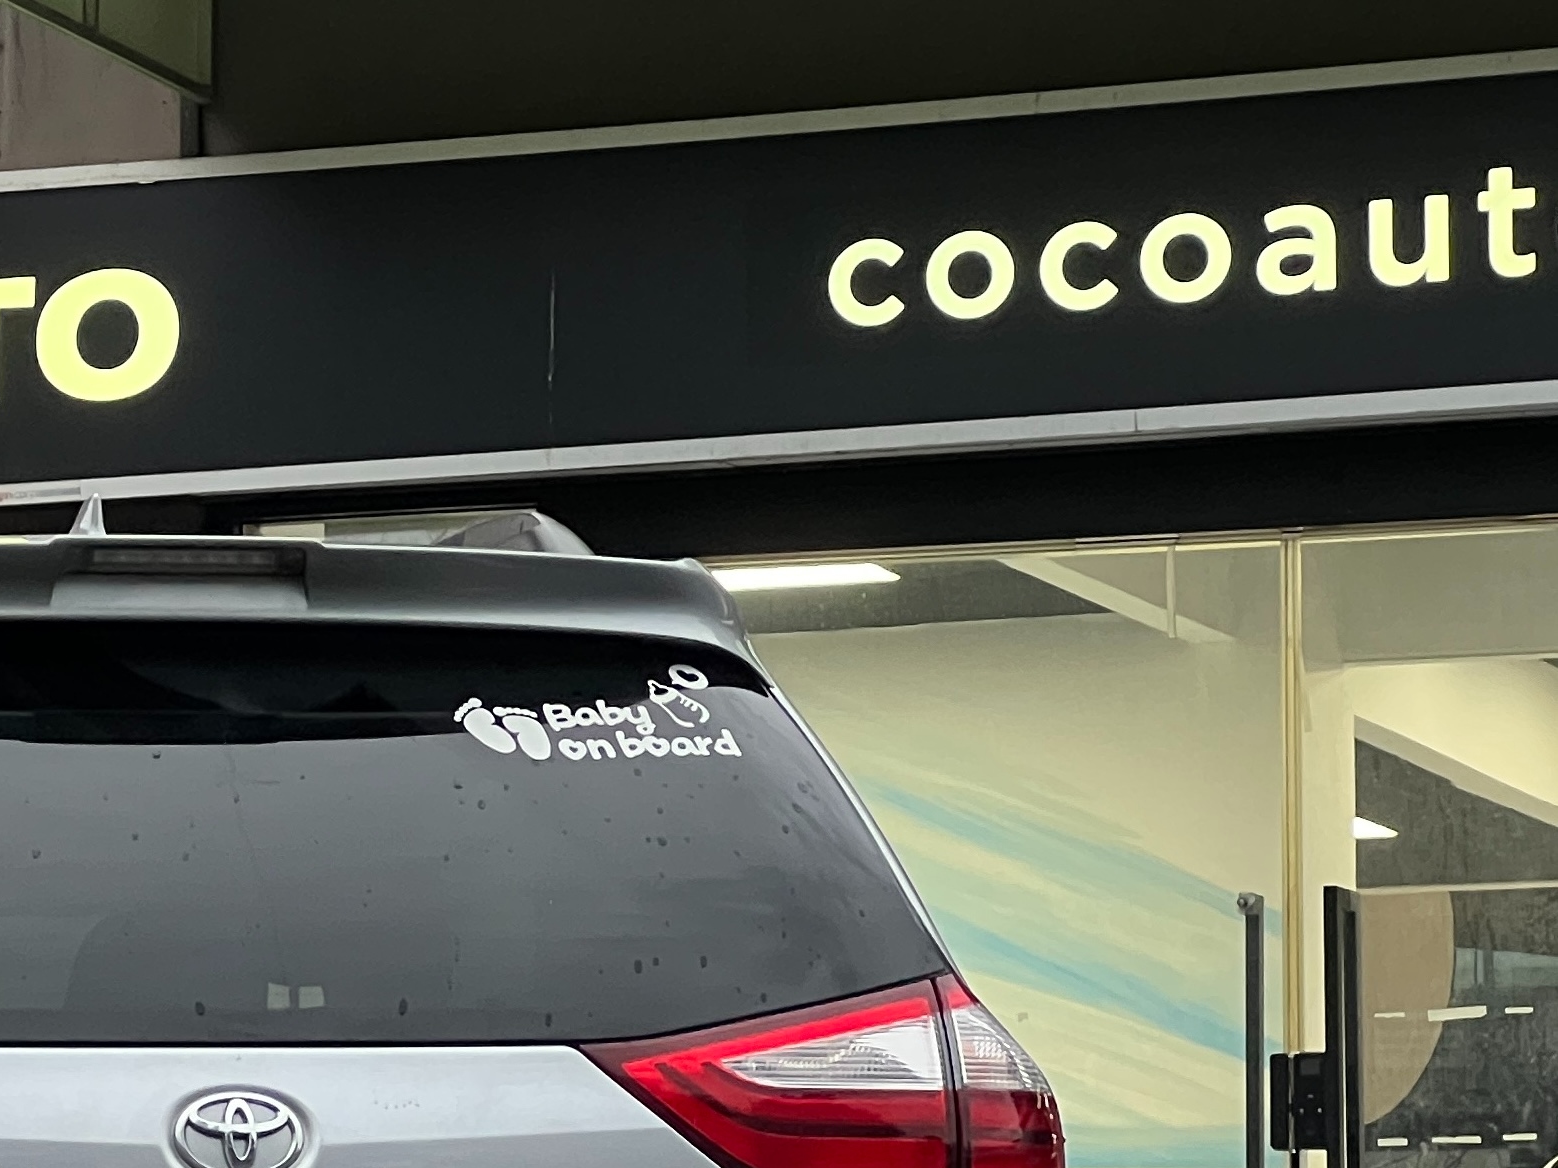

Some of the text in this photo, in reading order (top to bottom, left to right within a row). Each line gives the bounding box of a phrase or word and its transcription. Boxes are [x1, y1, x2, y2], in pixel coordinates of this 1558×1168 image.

[827, 166, 1537, 327] cocoaut
[543, 699, 656, 735] Baby
[558, 728, 742, 760] on board
